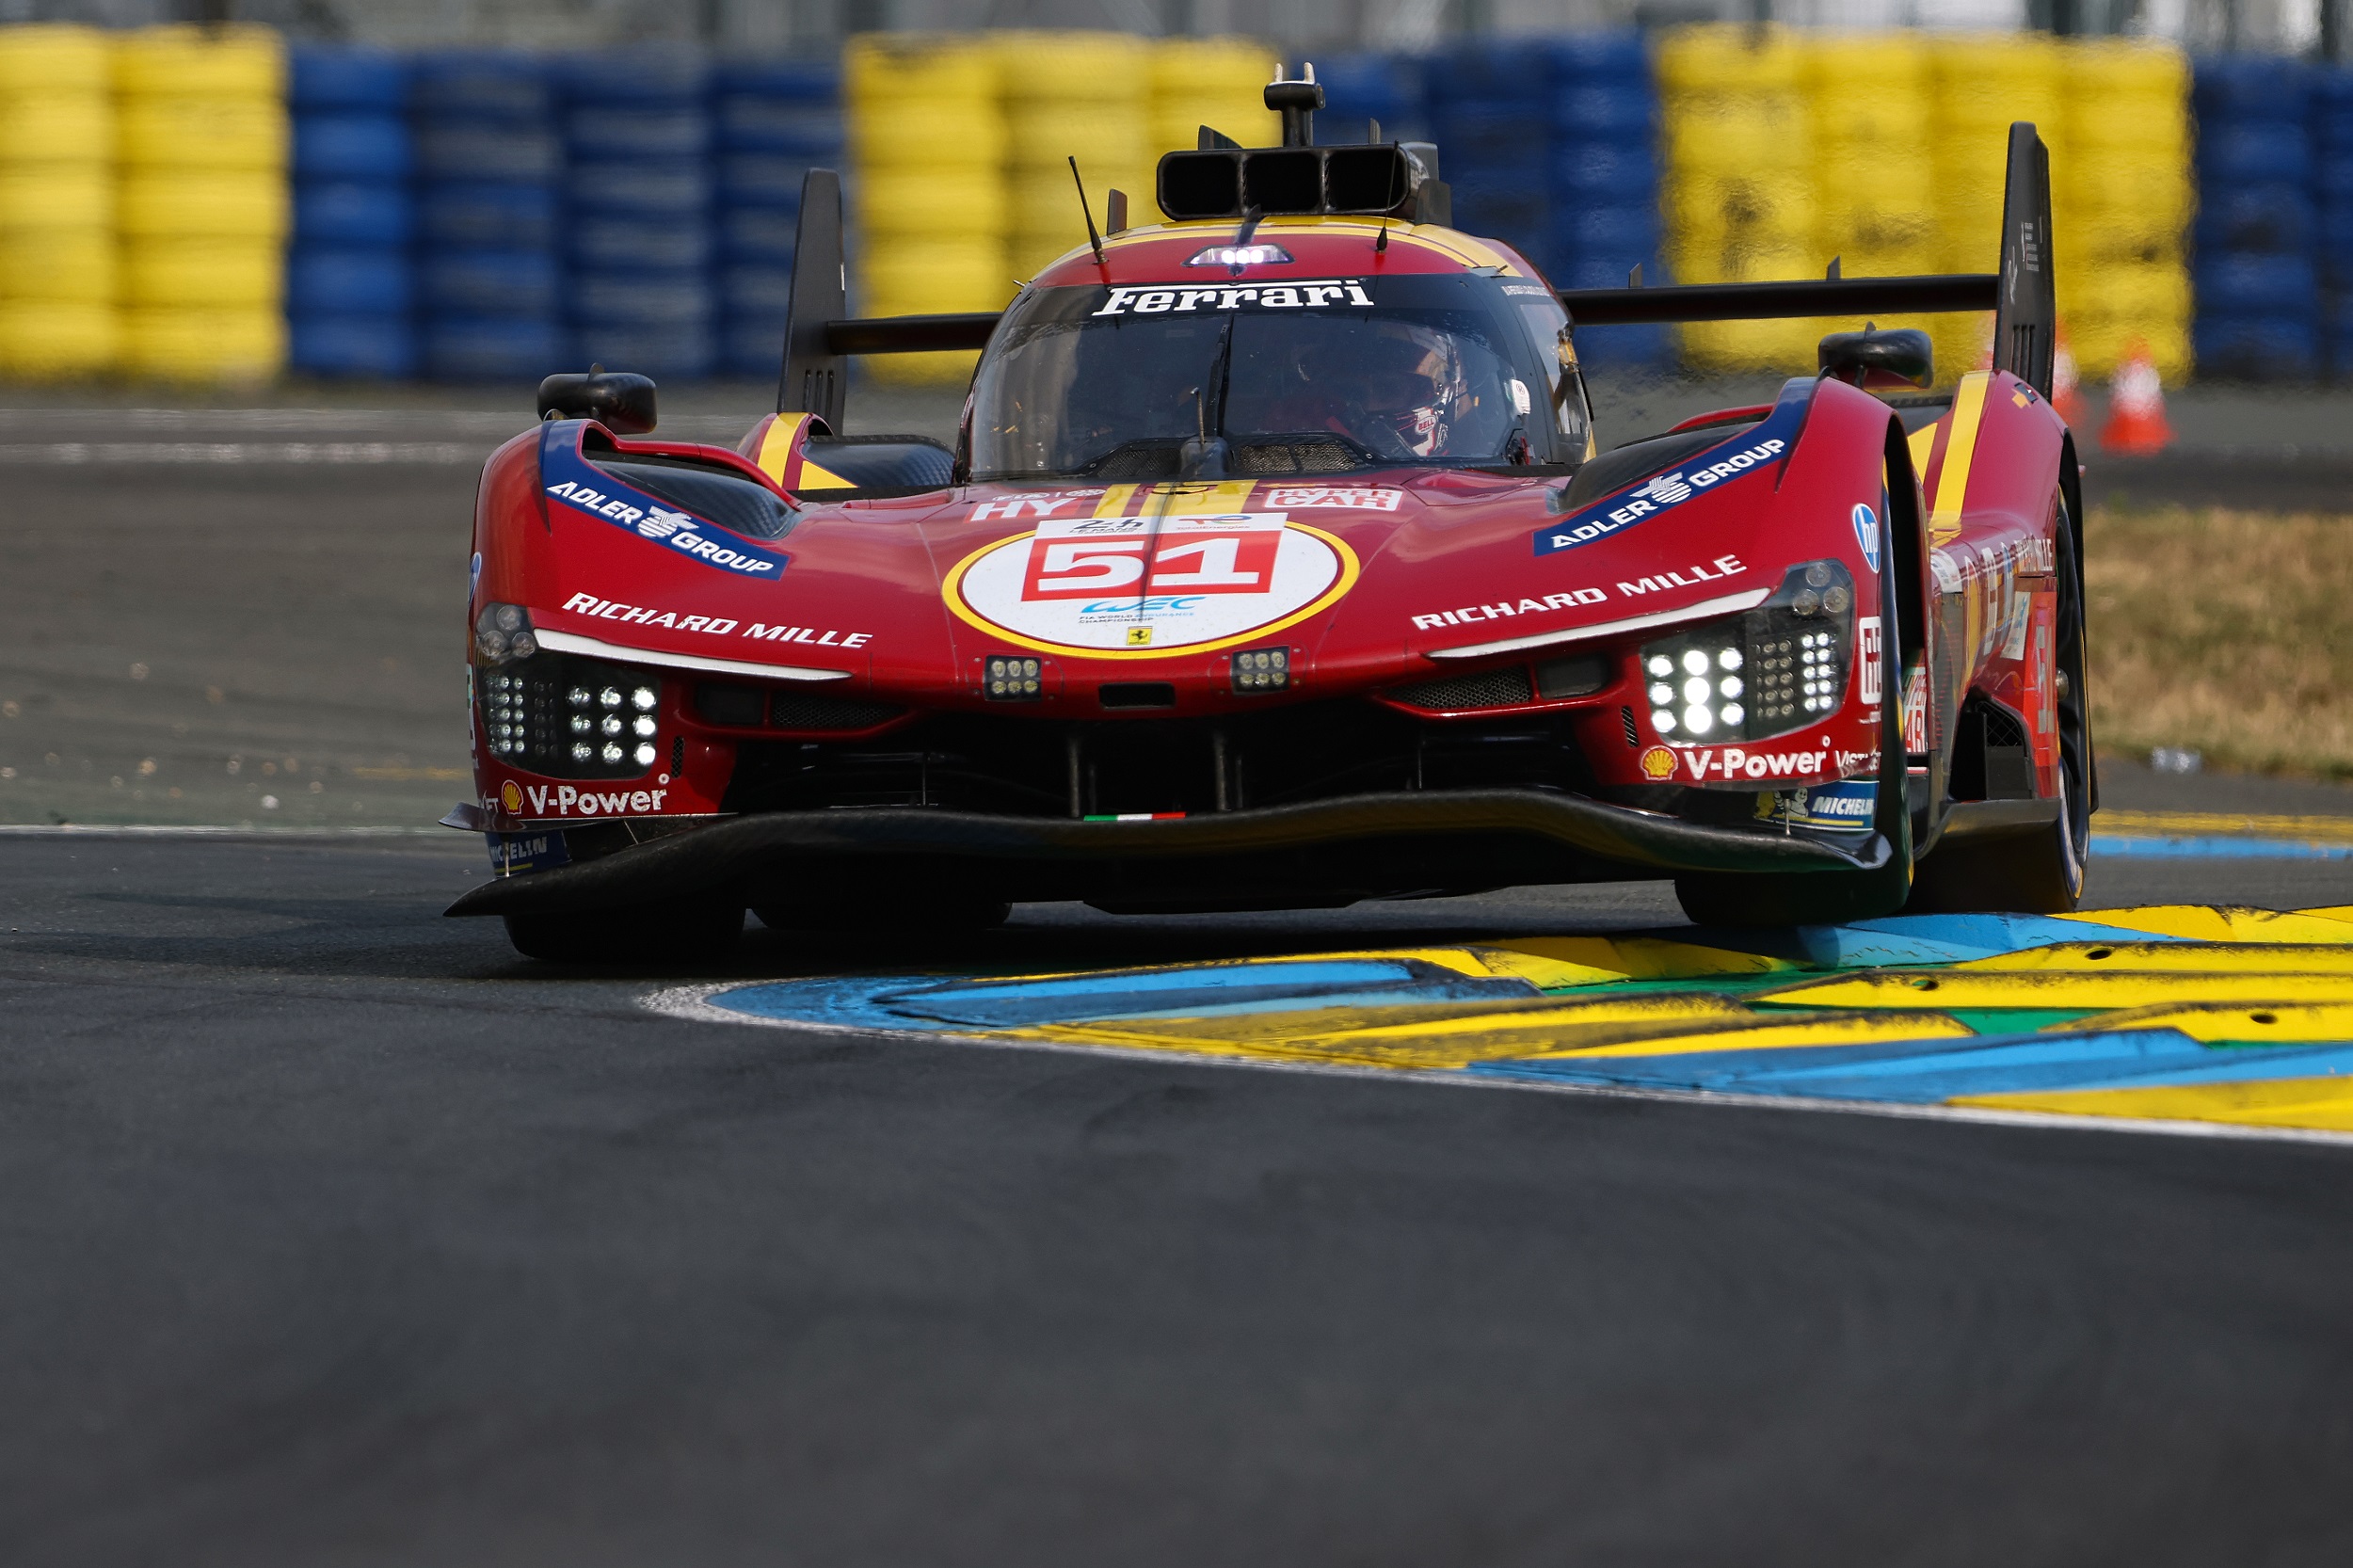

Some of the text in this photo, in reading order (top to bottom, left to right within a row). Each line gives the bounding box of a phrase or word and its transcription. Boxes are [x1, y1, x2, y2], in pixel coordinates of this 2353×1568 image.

[1091, 280, 1375, 316] Ferrari
[1418, 419, 1434, 430] BELL
[1273, 495, 1388, 508] CAR
[1276, 488, 1394, 497] HYPER
[1549, 439, 1785, 549] ADLER GROUP
[969, 497, 1078, 521] HY
[546, 481, 775, 572] ADLER GROUP
[1037, 537, 1260, 592] 51
[1080, 596, 1207, 613] WEC
[1412, 554, 1748, 631] RICHARD MILLE
[562, 592, 873, 648] RICHARD MILLE
[1684, 748, 1827, 780] V-Power
[526, 785, 667, 816] V-Power
[489, 836, 548, 862] MICELIN
